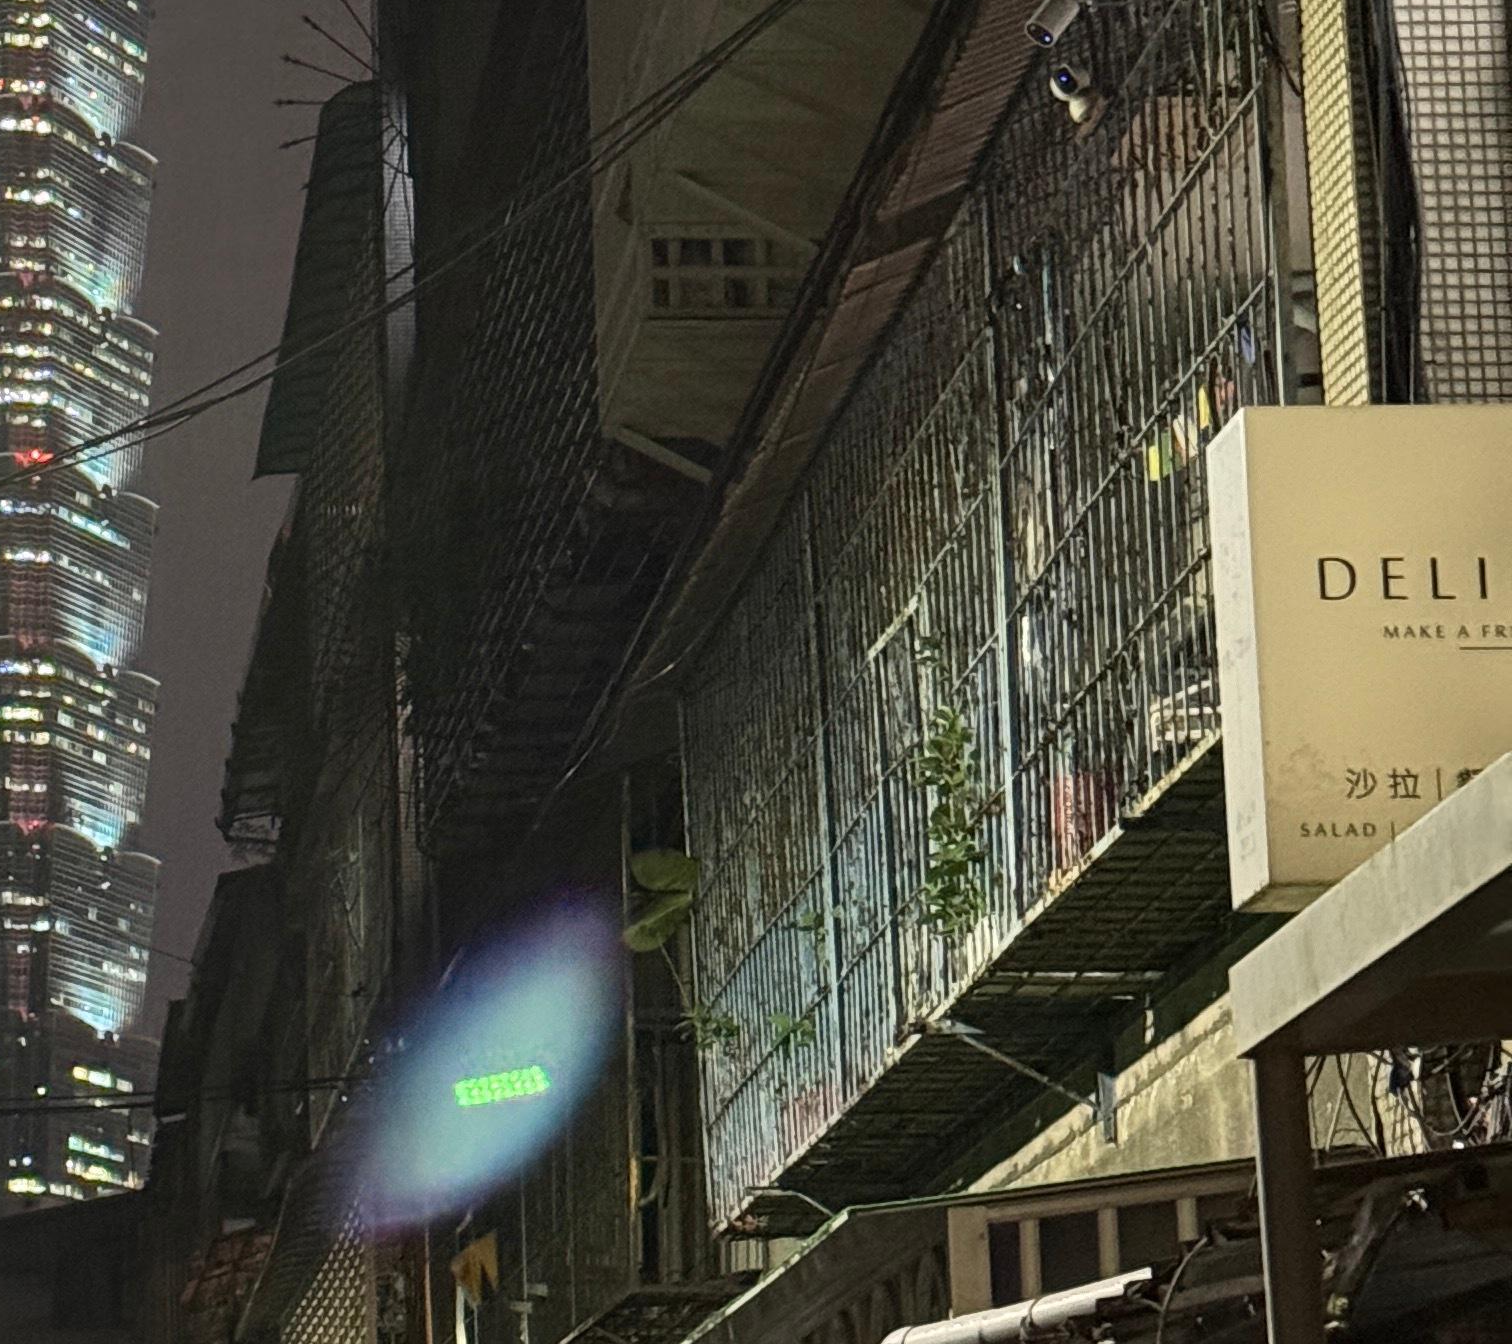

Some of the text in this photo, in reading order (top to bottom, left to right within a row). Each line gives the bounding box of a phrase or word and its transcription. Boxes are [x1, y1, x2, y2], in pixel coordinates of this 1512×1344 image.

[1383, 624, 1512, 639] MAKE A FR
[1345, 767, 1422, 800] 沙拉
[1299, 821, 1377, 838] SALAD
